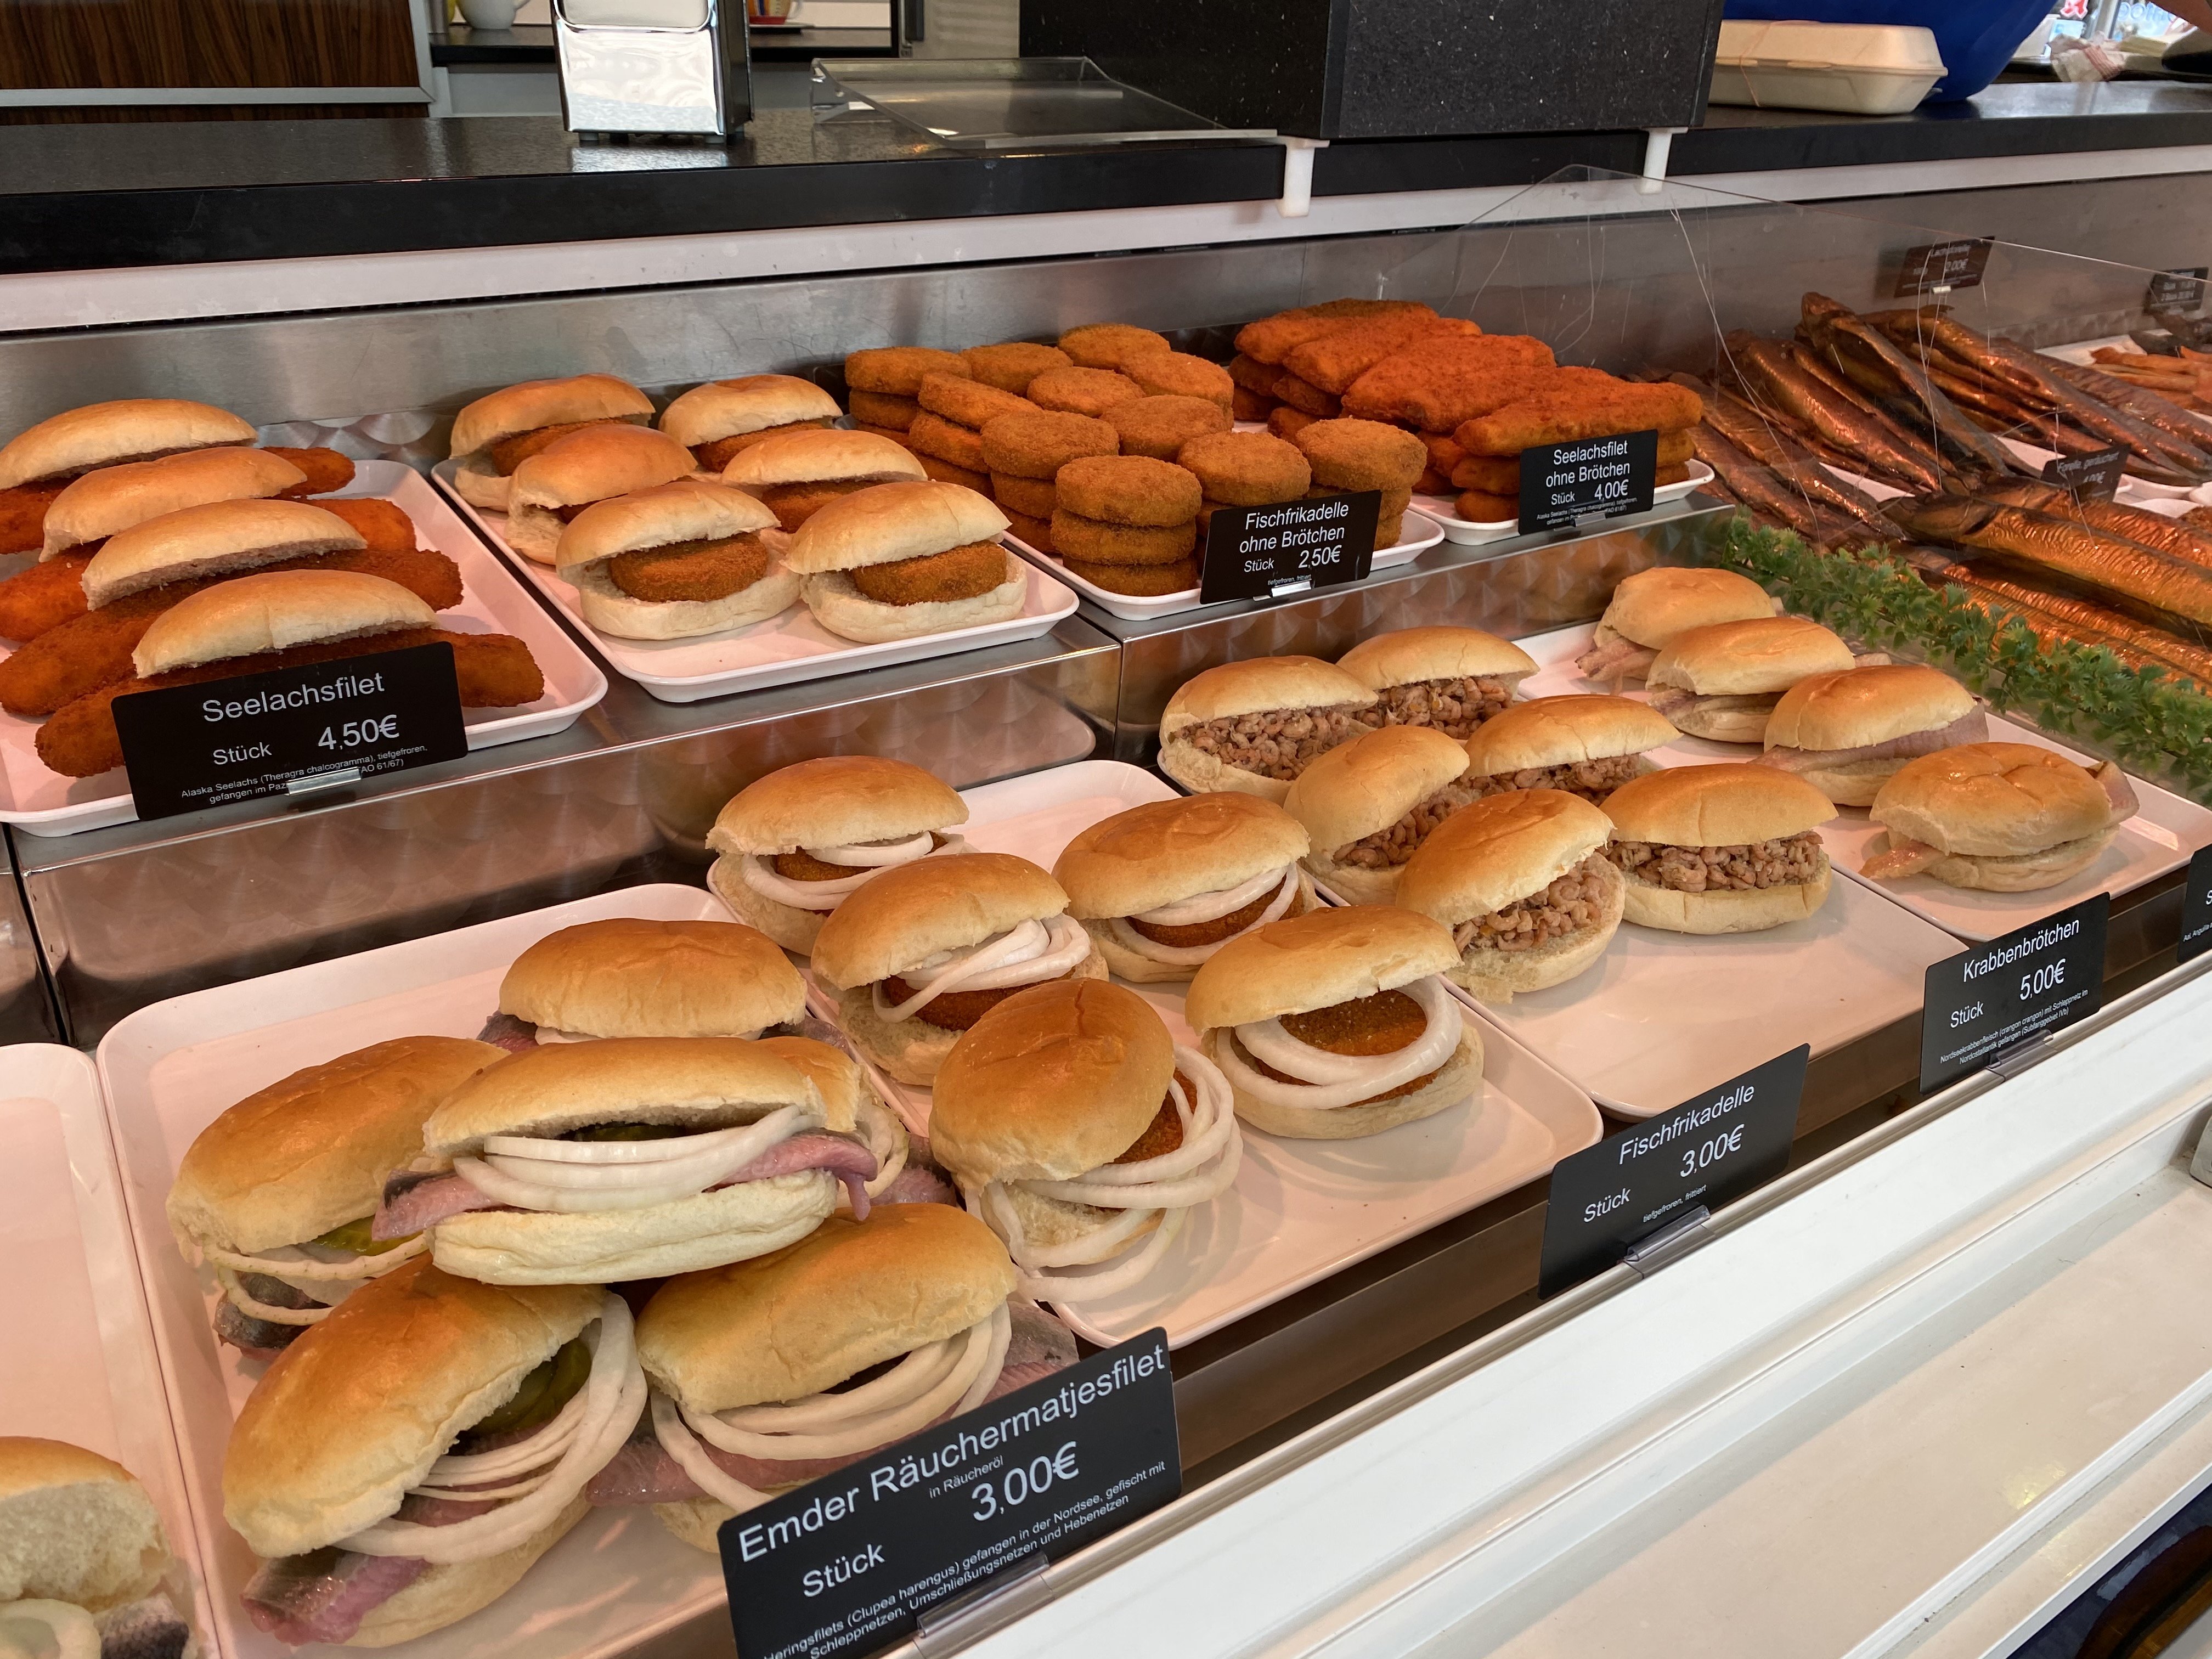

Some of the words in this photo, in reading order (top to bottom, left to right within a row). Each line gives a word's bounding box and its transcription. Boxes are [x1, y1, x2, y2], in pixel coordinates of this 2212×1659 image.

[1546, 471, 1575, 487] ohne
[1579, 462, 1630, 482] Brötchen
[1554, 439, 1628, 465] Seelachsfilet
[1245, 501, 1349, 530] Fischfrikadelle
[1551, 492, 1575, 505] Stück
[1594, 479, 1629, 502] 4,00€
[1240, 536, 1277, 553] ohne
[1282, 527, 1345, 548] Brötchen
[1244, 558, 1274, 572] Stück
[1298, 545, 1342, 569] 2,50€
[203, 672, 385, 722] Seelachsfilet
[213, 742, 272, 765] Stück
[318, 714, 400, 750] 4,50€
[182, 786, 213, 798] Alaska
[216, 777, 258, 791] Seelachs
[261, 768, 304, 784] (Theragra
[307, 755, 376, 774] chalcogramma),
[378, 746, 427, 760] tiefgefroren,
[209, 789, 252, 804] gefangen
[377, 759, 404, 770] 61/67)
[1963, 919, 2079, 983] Krabbenbrötchen
[2019, 958, 2066, 1000] 5,00€
[1940, 1031, 1998, 1064] Nordseekrabbenfleisch
[1999, 1020, 2021, 1037] (crangon
[2022, 1008, 2044, 1025] crangon)
[2044, 1005, 2052, 1014] mit
[2052, 992, 2081, 1011] Schleppnetz
[2081, 989, 2088, 997] im
[1950, 1001, 1984, 1029] Stück
[1959, 1041, 1997, 1065] Nordostatlantik
[1997, 1030, 2021, 1048] gefangen
[1618, 1085, 1754, 1165] Fischfrikadelle
[1680, 1124, 1745, 1178] 3,00€
[1583, 1188, 1631, 1223] Stück
[738, 1487, 860, 1562] Emder
[871, 1343, 1165, 1502] Räuchermatjesfilet
[929, 1487, 941, 1499] in
[944, 1454, 1003, 1492] Räucheröl
[972, 1441, 1080, 1522] 3,00€
[848, 1595, 896, 1627] (Clupea
[899, 1562, 960, 1600] harengus)
[962, 1536, 1016, 1571] gefangen
[1019, 1529, 1029, 1541] in
[1032, 1519, 1052, 1534] der
[1053, 1494, 1103, 1523] Nordsee,
[1105, 1470, 1147, 1499] gefischt
[1149, 1460, 1166, 1477] mit
[802, 1543, 886, 1599] Stück
[810, 1607, 906, 1659] Schleppnetzen,
[909, 1539, 1037, 1610] Umschließungsnetzen
[1040, 1526, 1062, 1545] und
[1064, 1495, 1129, 1533] Hebenetzen
